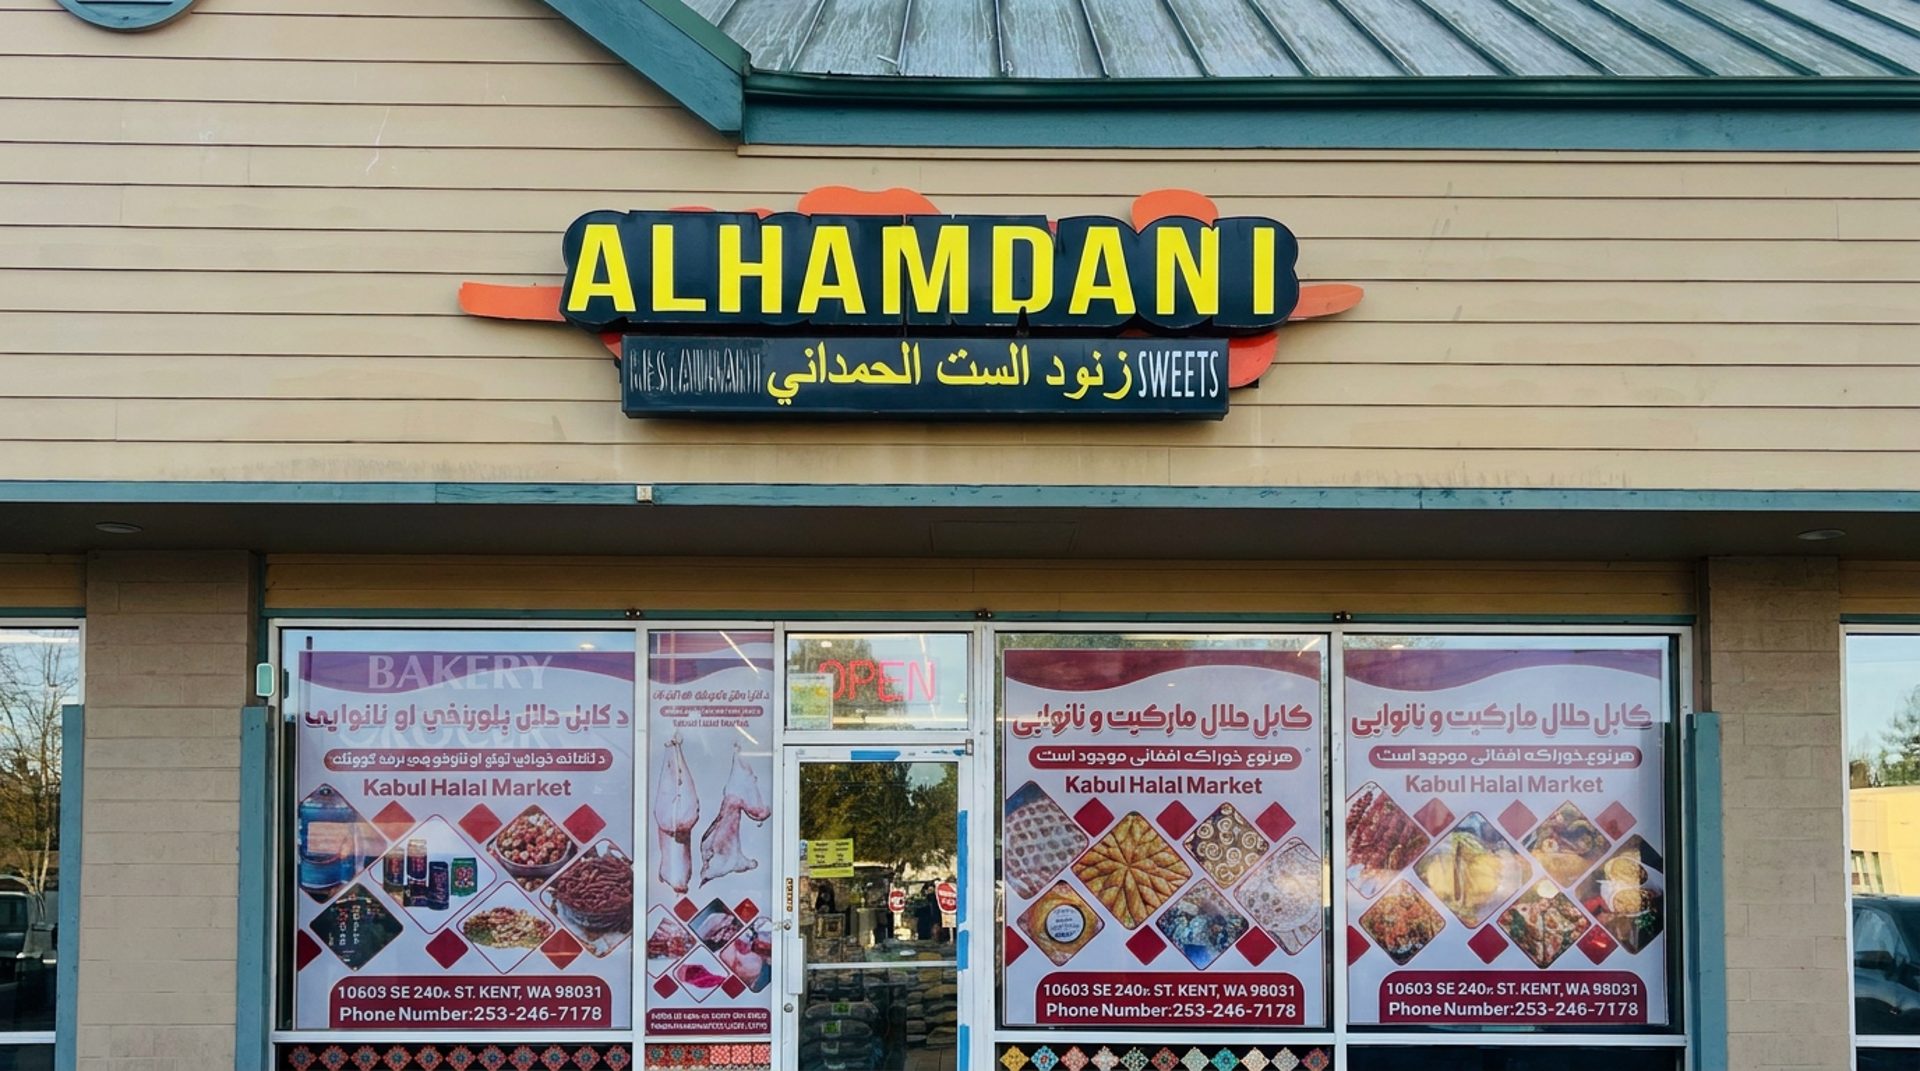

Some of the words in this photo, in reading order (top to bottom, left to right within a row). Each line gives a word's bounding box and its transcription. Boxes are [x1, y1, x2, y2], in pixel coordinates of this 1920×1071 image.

[567, 224, 1275, 315] ALHAMDANI
[767, 341, 922, 405] الحمداني
[936, 342, 1030, 386] الست
[1045, 349, 1133, 400] زنود
[1138, 350, 1219, 398] SWEETS
[368, 655, 553, 689] BAKERY
[818, 659, 936, 702] OPEN
[1089, 710, 1103, 733] و
[1201, 703, 1249, 737] حلال
[1253, 703, 1313, 737] کابل
[1430, 710, 1443, 733] و
[1542, 703, 1590, 736] حلال
[1594, 703, 1653, 736] کابل
[364, 779, 426, 796] Kabul
[431, 779, 487, 796] Halal
[493, 779, 572, 796] Market
[1066, 776, 1125, 793] Kabul
[1130, 776, 1182, 793] Halal
[1187, 776, 1262, 793] Market
[1406, 775, 1465, 793] Kabul
[1471, 775, 1523, 793] Halal
[1528, 775, 1603, 793] Market
[338, 985, 386, 999] 10603
[391, 985, 410, 999] SE
[480, 985, 523, 1001] KENT,
[527, 985, 552, 999] WA
[555, 985, 601, 999] 98031
[1044, 984, 1089, 996] 10603
[1093, 984, 1111, 996] SE
[1179, 984, 1219, 999] KENT,
[1224, 984, 1247, 996] WA
[1250, 984, 1295, 996] 98031
[1387, 983, 1432, 995] 10603
[1437, 983, 1455, 995] SE
[1521, 983, 1563, 998] KENT,
[1566, 983, 1590, 995] WA
[340, 1006, 395, 1022] Phone
[1047, 1003, 1099, 1017] Phone
[1390, 1002, 1441, 1016] Phone
